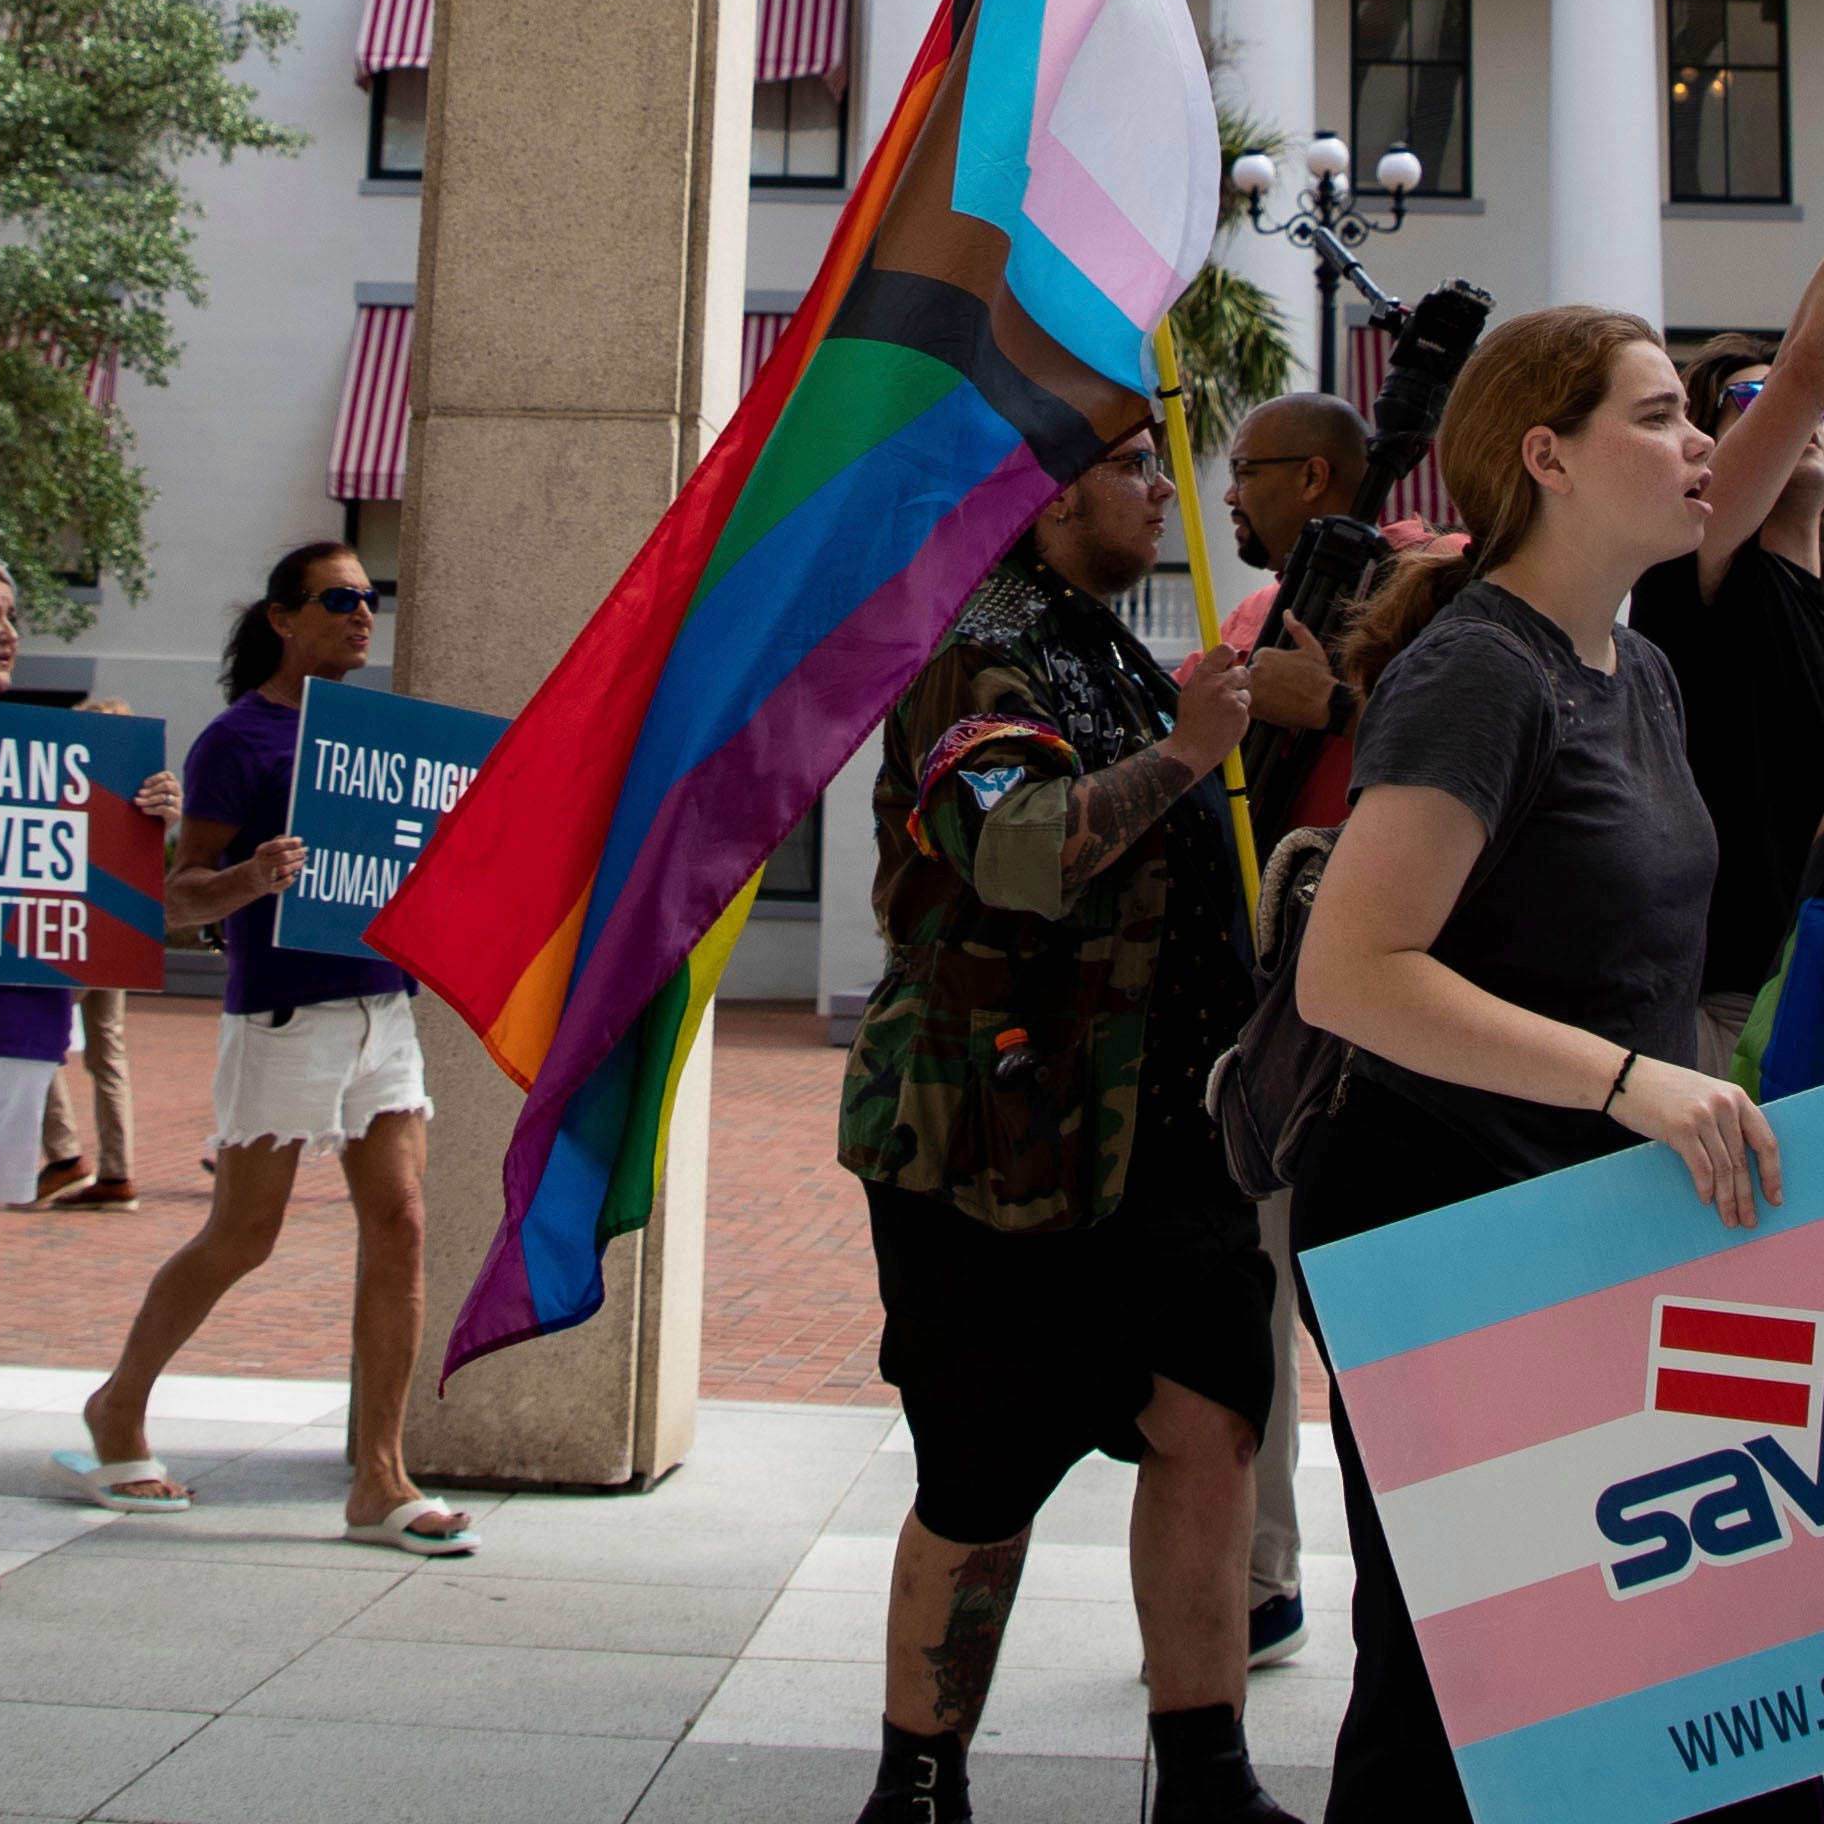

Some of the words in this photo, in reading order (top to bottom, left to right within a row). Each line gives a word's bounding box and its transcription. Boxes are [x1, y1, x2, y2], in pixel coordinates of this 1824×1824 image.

[314, 738, 406, 804] TRANS
[394, 819, 423, 848] =
[298, 847, 401, 909] HUMAN
